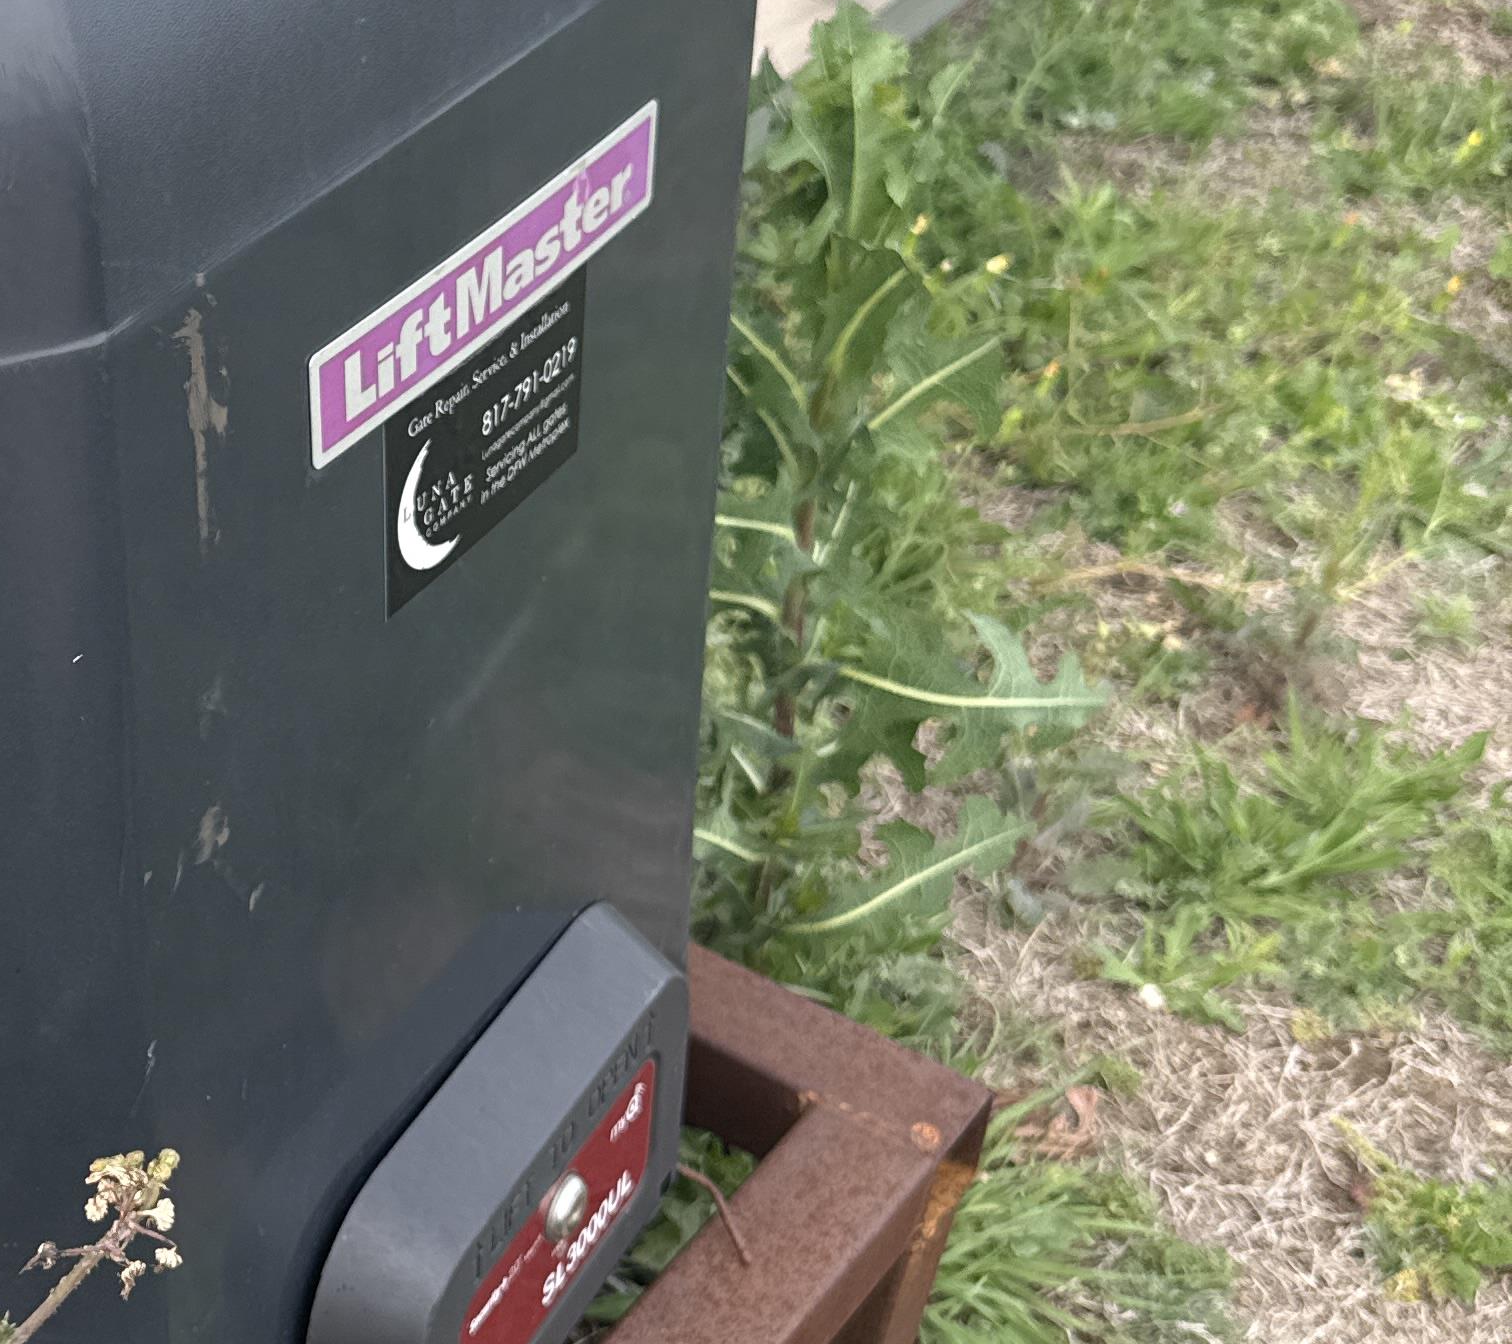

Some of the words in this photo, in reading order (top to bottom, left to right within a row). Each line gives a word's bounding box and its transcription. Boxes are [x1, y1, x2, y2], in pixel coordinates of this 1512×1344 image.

[344, 163, 634, 422] LiftMaster
[407, 412, 434, 437] Gate
[509, 341, 520, 359] &
[520, 300, 570, 351] Installation
[481, 336, 578, 437] 817-791-0219
[485, 439, 527, 483] Servicing
[526, 424, 542, 448] ALL
[542, 401, 568, 434] gates
[490, 475, 507, 496] the
[506, 453, 528, 483] DFW
[527, 417, 571, 463] Metroplex
[403, 471, 457, 524] LUNA
[423, 473, 473, 526] GATE
[425, 493, 472, 538] COMPANY
[542, 1168, 634, 1308] SL3000UL
